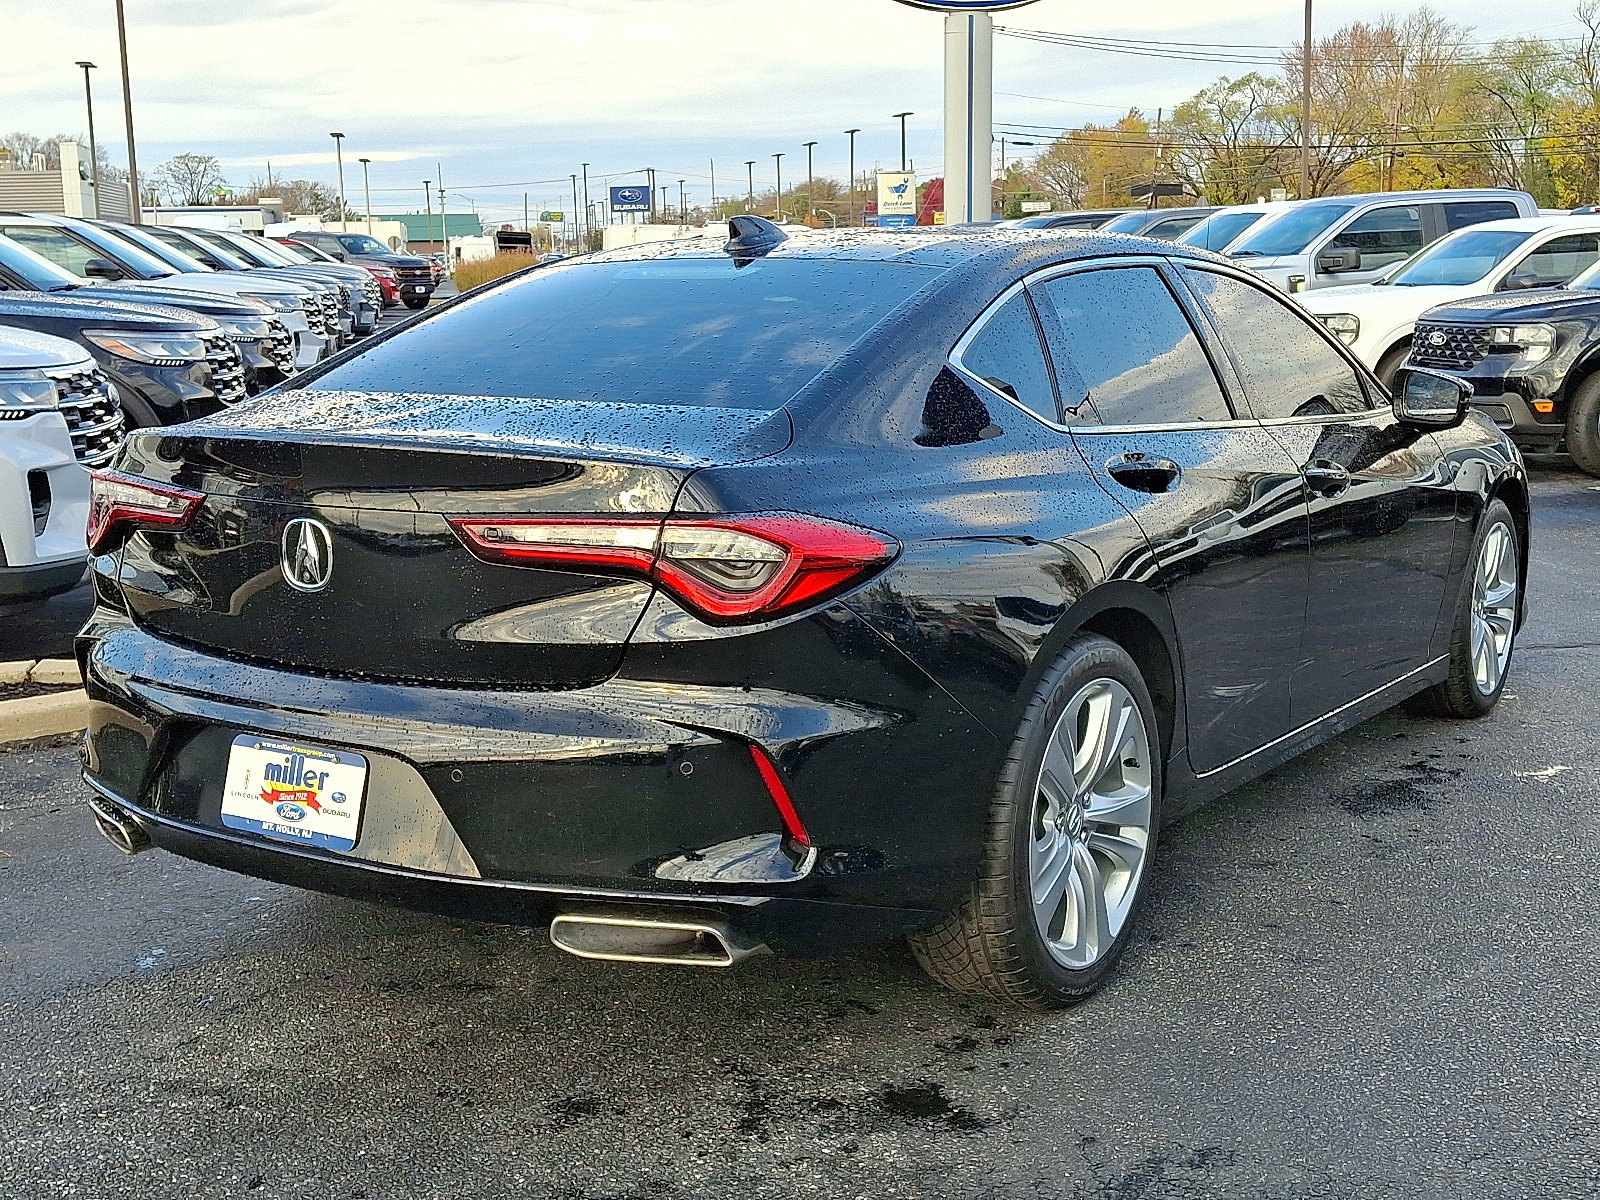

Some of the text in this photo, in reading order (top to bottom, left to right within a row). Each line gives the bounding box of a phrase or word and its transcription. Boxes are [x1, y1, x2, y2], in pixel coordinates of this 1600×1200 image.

[264, 754, 330, 791] miller
[230, 790, 258, 800] LINCOLN
[278, 792, 308, 801] Since 1912
[280, 804, 302, 820] Ford
[322, 807, 351, 818] SUBARU
[262, 822, 312, 838] MT. HOLLY, NJ
